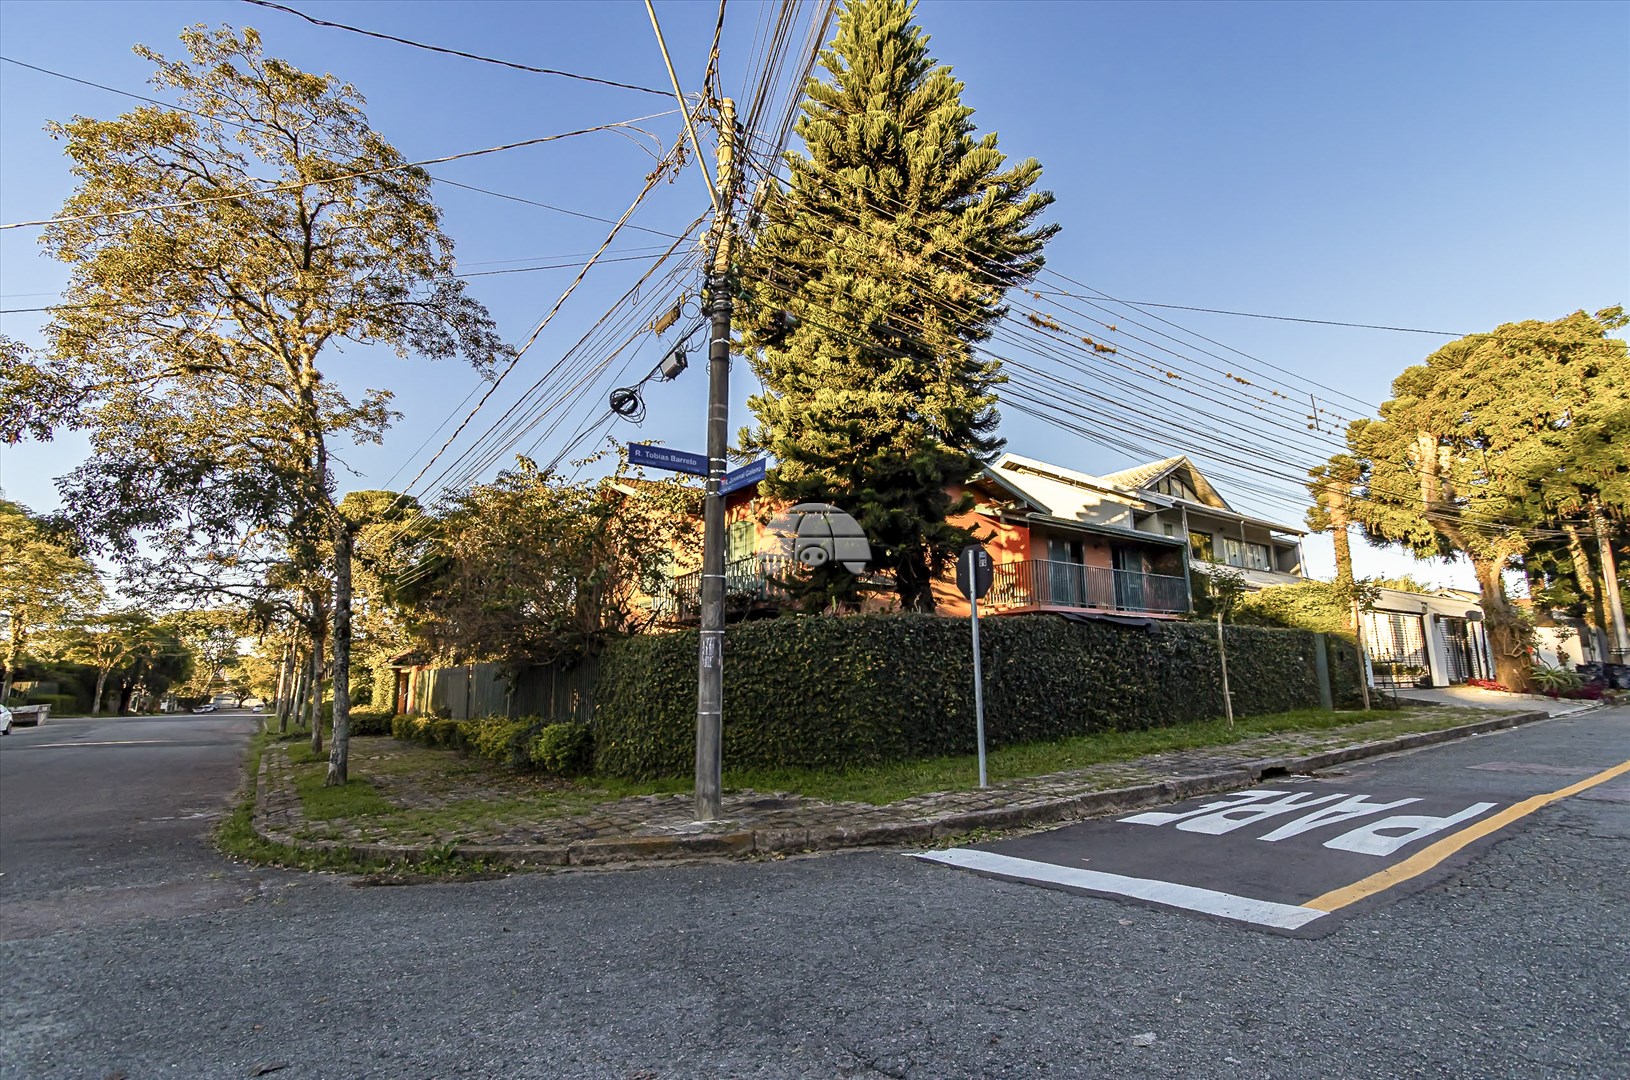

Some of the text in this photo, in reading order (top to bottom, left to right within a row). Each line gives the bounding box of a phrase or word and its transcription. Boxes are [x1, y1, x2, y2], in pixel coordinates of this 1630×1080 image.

[634, 449, 643, 457] R.
[645, 450, 669, 461] Tobias
[670, 455, 697, 466] Barreto
[1116, 790, 1498, 857] PARE
